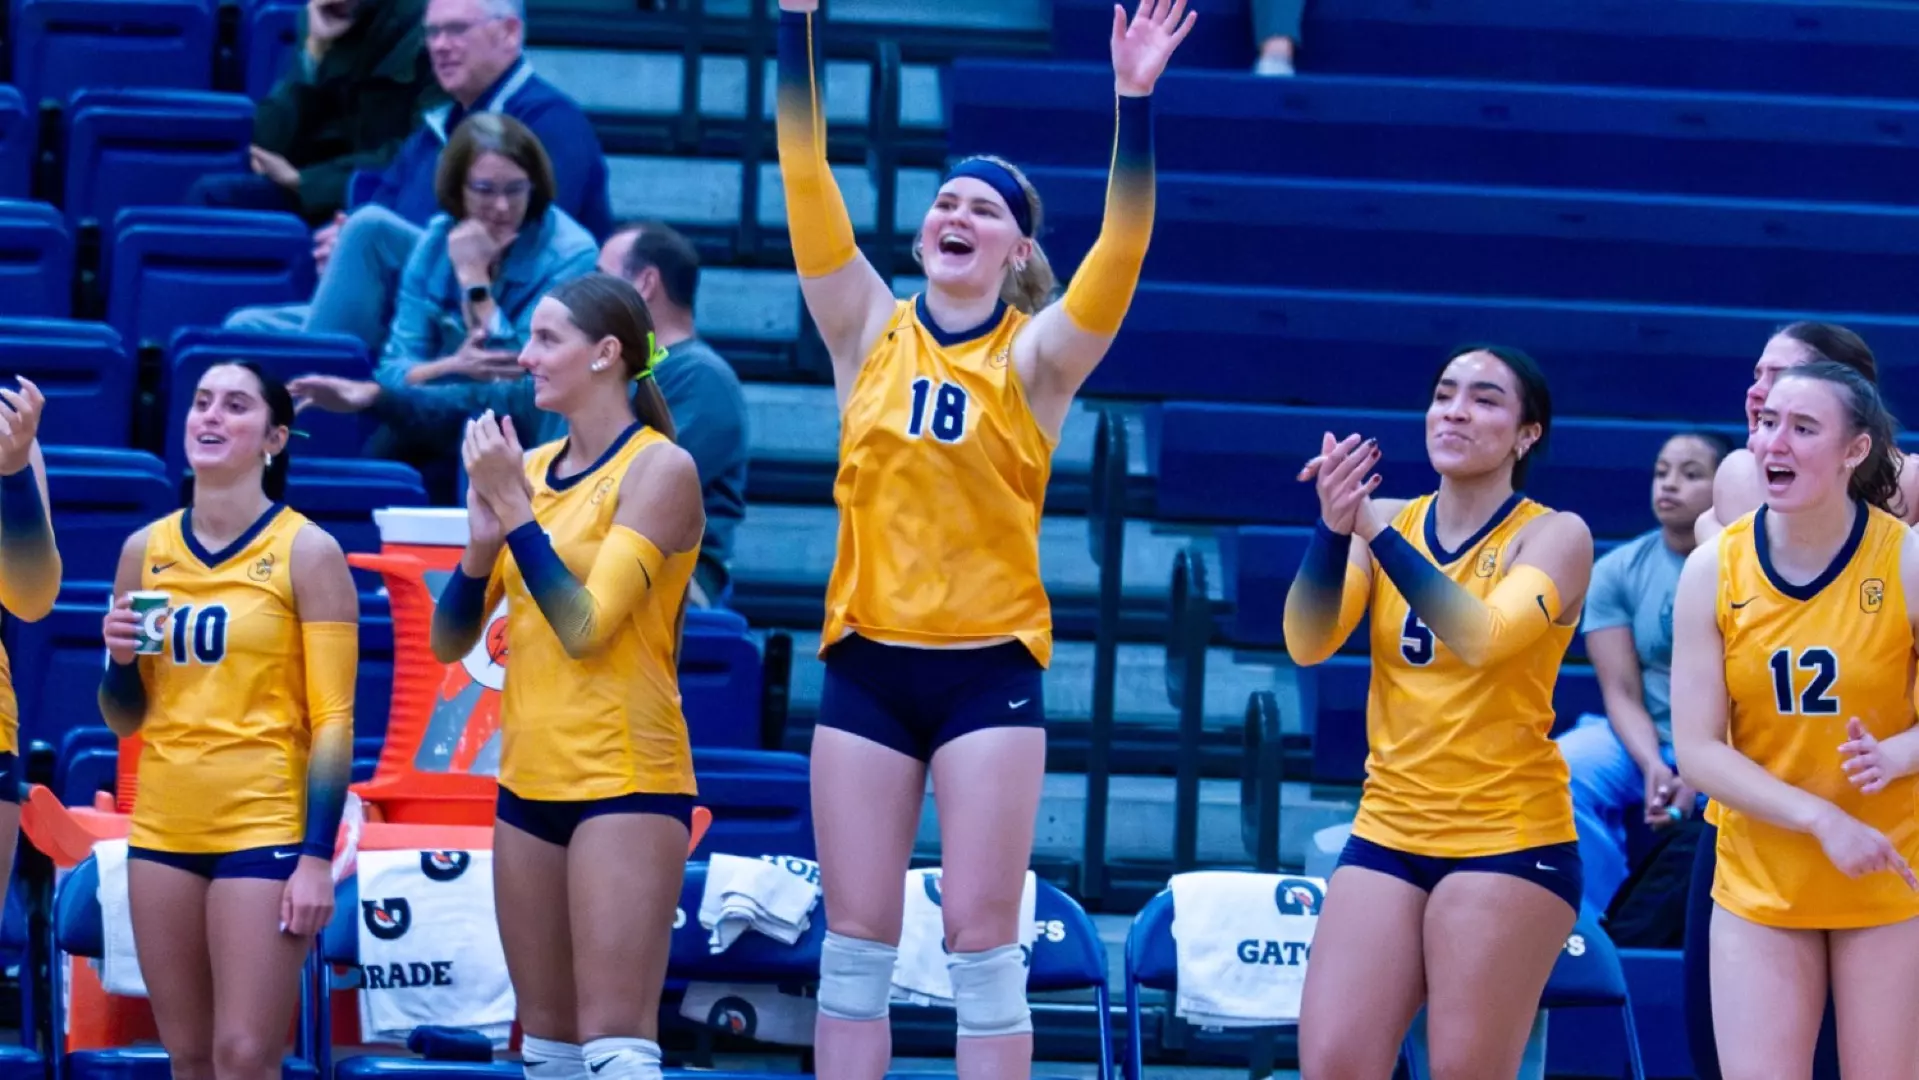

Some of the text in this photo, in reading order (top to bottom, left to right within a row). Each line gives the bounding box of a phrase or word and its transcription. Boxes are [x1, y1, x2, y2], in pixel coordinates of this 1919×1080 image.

[907, 376, 969, 444] 18
[171, 603, 230, 666] 10
[1400, 605, 1435, 667] 5
[1768, 646, 1841, 716] 12
